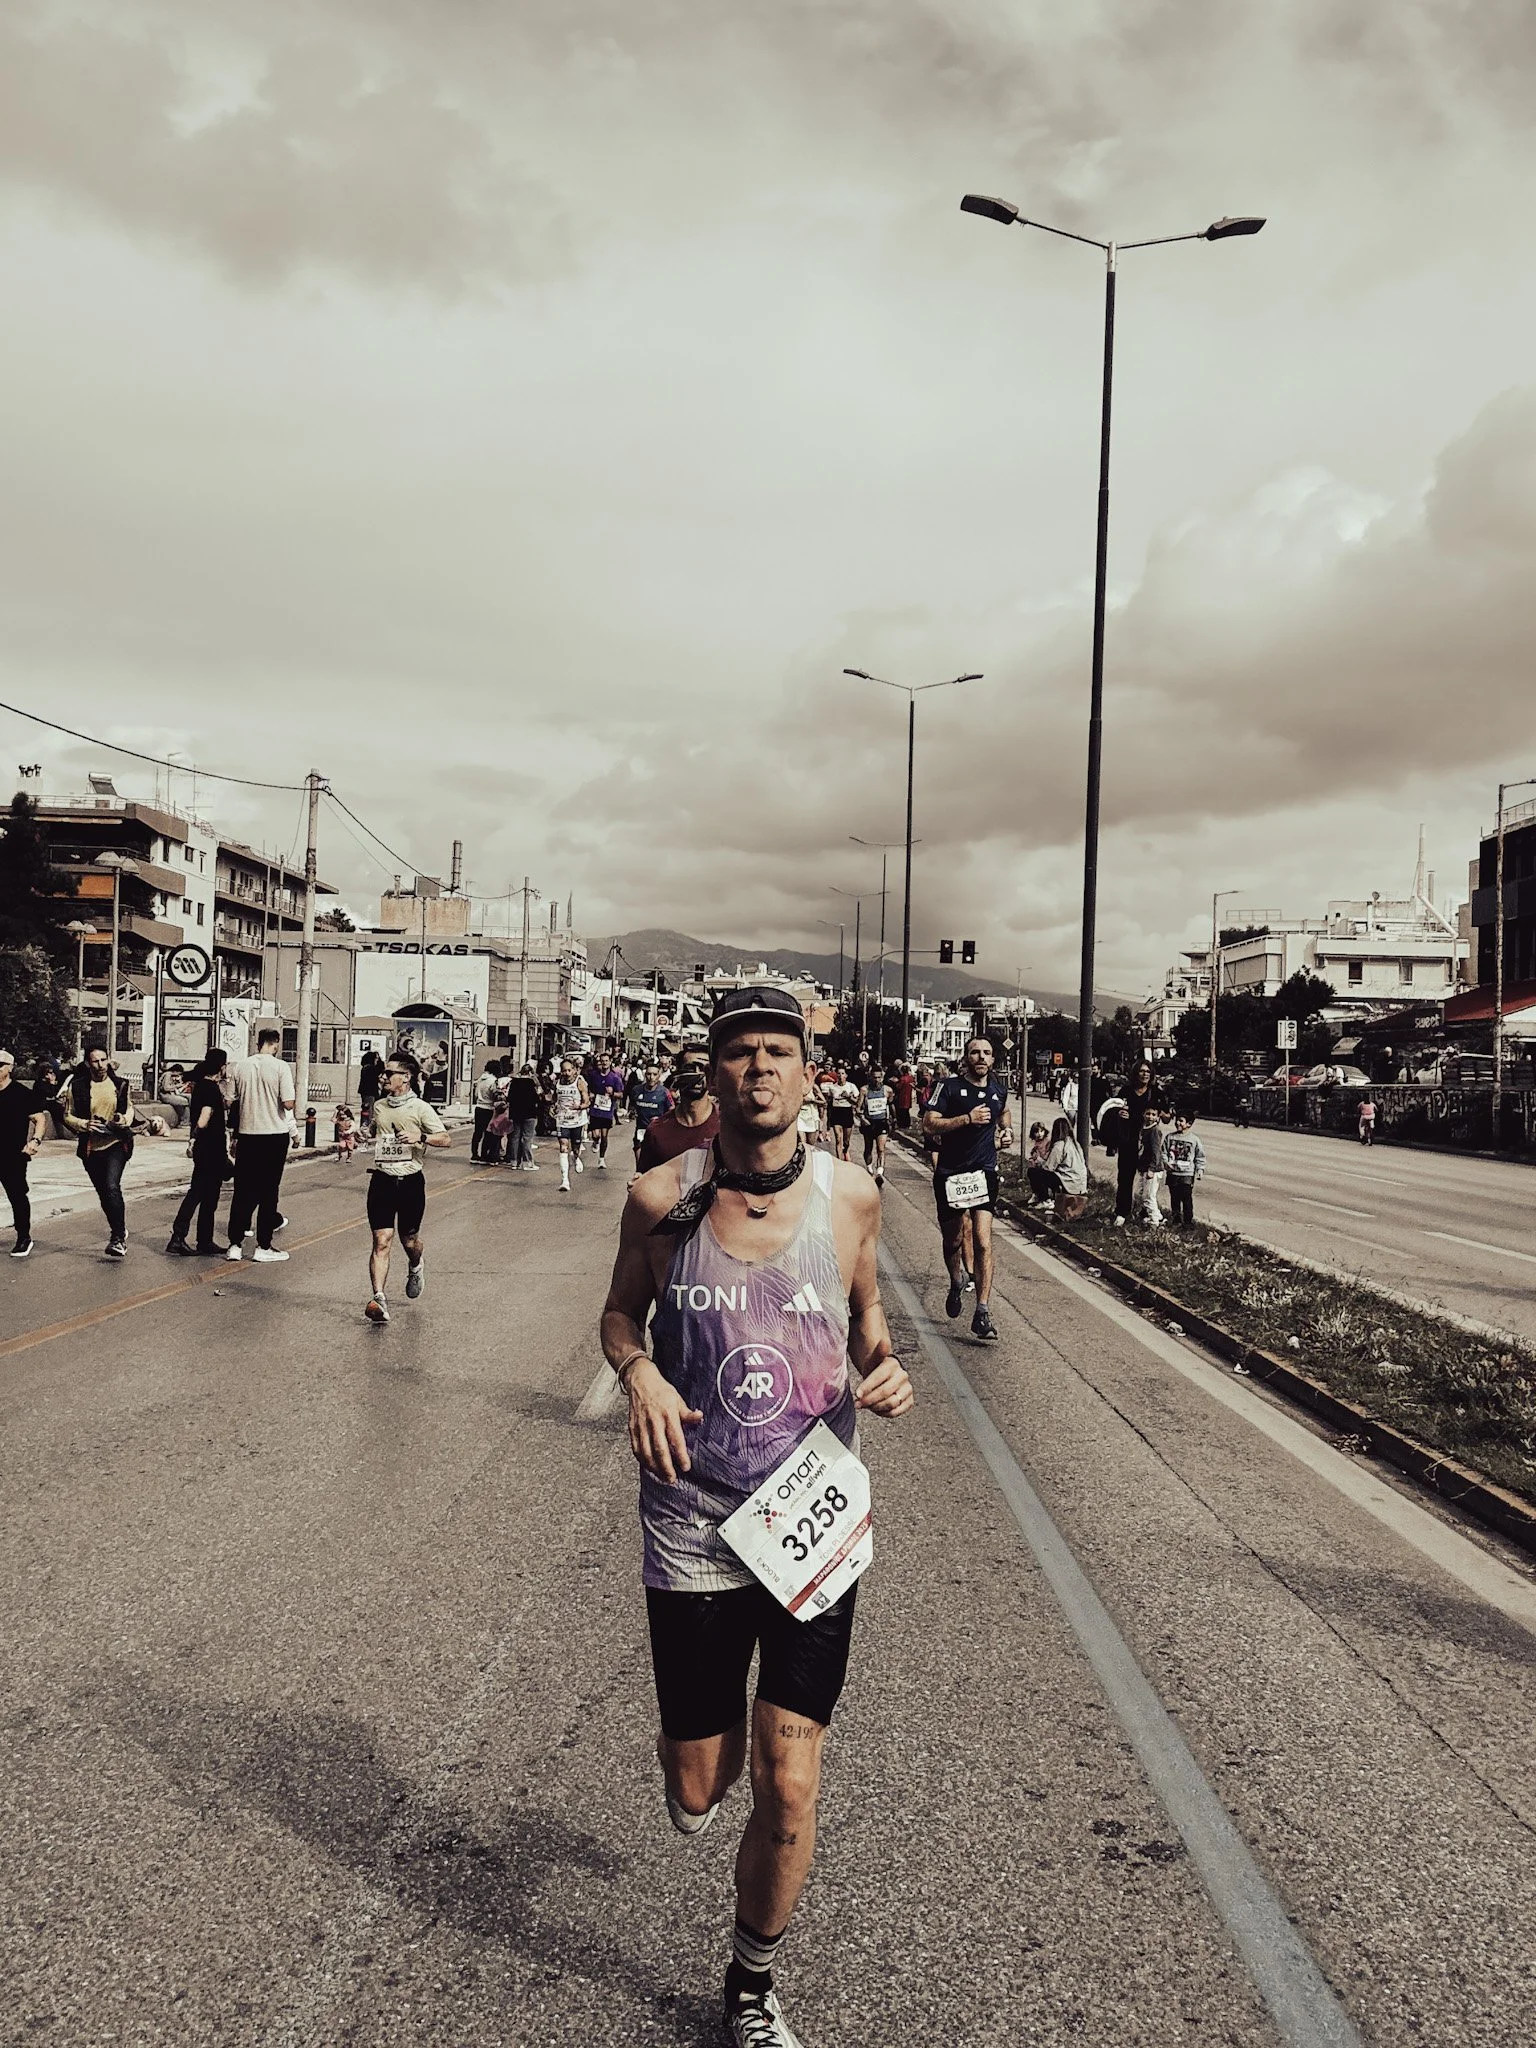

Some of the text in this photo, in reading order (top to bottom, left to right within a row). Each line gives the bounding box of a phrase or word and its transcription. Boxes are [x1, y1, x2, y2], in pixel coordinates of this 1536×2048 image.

[375, 942, 469, 955] TSOKAS
[1414, 1014, 1440, 1029] sweet
[671, 1284, 747, 1312] TONI
[781, 1485, 848, 1562] 3258
